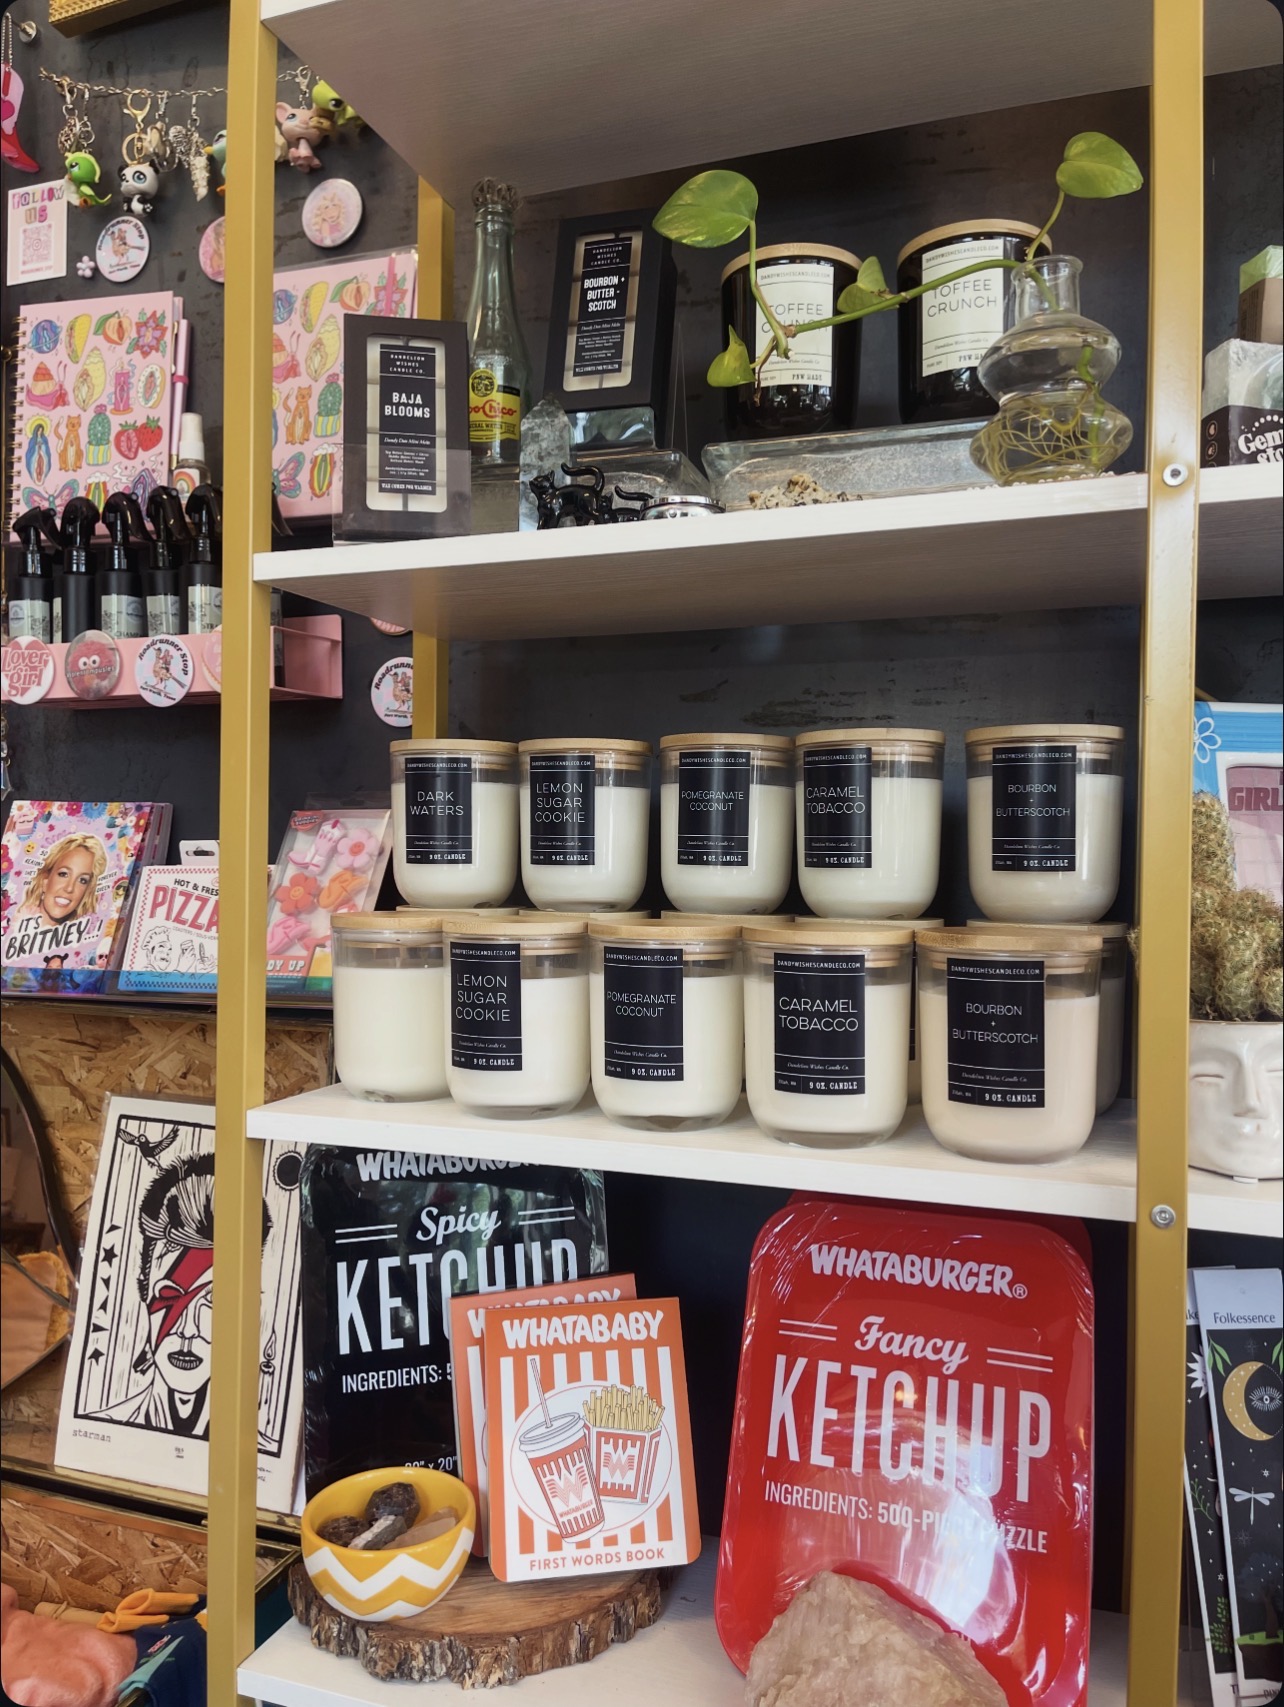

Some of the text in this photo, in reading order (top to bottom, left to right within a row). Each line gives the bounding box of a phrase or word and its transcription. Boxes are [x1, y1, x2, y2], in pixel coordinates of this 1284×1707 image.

[13, 185, 64, 209] FOLLOW
[25, 205, 48, 224] US
[584, 275, 619, 289] BOURBON
[932, 279, 992, 299] TOFFEE
[586, 288, 615, 301] BUTTER
[587, 299, 617, 312] SCOTCH
[927, 296, 997, 317] CRUNCH
[392, 392, 423, 405] BAJA
[384, 405, 431, 418] BLOOMS
[1, 647, 50, 673] Lover
[138, 637, 189, 676] Roadrunner Stop
[8, 667, 43, 697] girl
[536, 782, 583, 794] LEMON
[681, 790, 744, 800] POMEGRANATE
[806, 785, 865, 799] CARAMEL
[1007, 783, 1057, 793] BOURBON
[417, 790, 454, 802] DARK
[536, 797, 583, 808] SUGAR
[1228, 786, 1283, 812] GIRL
[409, 805, 464, 816] WATERS
[689, 802, 734, 811] COCONUT
[806, 801, 866, 814] TOBACCO
[995, 807, 1071, 817] BUTTERSCOTCH
[534, 811, 586, 823] COOKIE
[840, 856, 865, 864] CANDLE
[1041, 859, 1069, 867] CANDLE
[173, 878, 191, 889] HOT
[192, 883, 200, 892] &
[18, 915, 42, 933] IT'S
[606, 953, 678, 961] DANDYWISHESCANDLECO.COM
[288, 960, 305, 972] UP
[777, 960, 861, 969] DANDYWISHESCANDLECO.COM
[950, 965, 1040, 975] DANDYWISHESCANDLECO.COM
[456, 973, 507, 988] LEMON
[457, 990, 507, 1005] SUGAR
[606, 991, 677, 1004] POMEGRANATE
[779, 996, 858, 1013] CARAMEL
[455, 1006, 511, 1022] COOKIE
[615, 1005, 664, 1017] COCONUT
[965, 1002, 1022, 1016] BOURBON
[778, 1014, 859, 1032] TOBACCO
[952, 1028, 1039, 1044] BUTTERSCOTCH
[489, 1058, 515, 1066] CANDLE
[637, 1068, 648, 1076] OZ.
[649, 1068, 676, 1077] CANDLE
[815, 1082, 828, 1090] OZ.
[829, 1081, 858, 1090] CANDLE
[984, 1093, 1037, 1103] 9 OZ. CANDLE
[416, 1205, 502, 1246] Spicy
[1213, 1311, 1276, 1324] Folkessence
[502, 1309, 664, 1349] WHATABABY
[854, 1315, 969, 1375] Fancy
[341, 1364, 442, 1394] INGREDIENTS:
[766, 1353, 1052, 1503] KETCHUP
[72, 1428, 112, 1443] starman
[765, 1480, 873, 1520] INGREDIENTS:
[559, 1499, 593, 1518] WHATABURGER
[529, 1547, 665, 1571] FIRST WORDS BOOK
